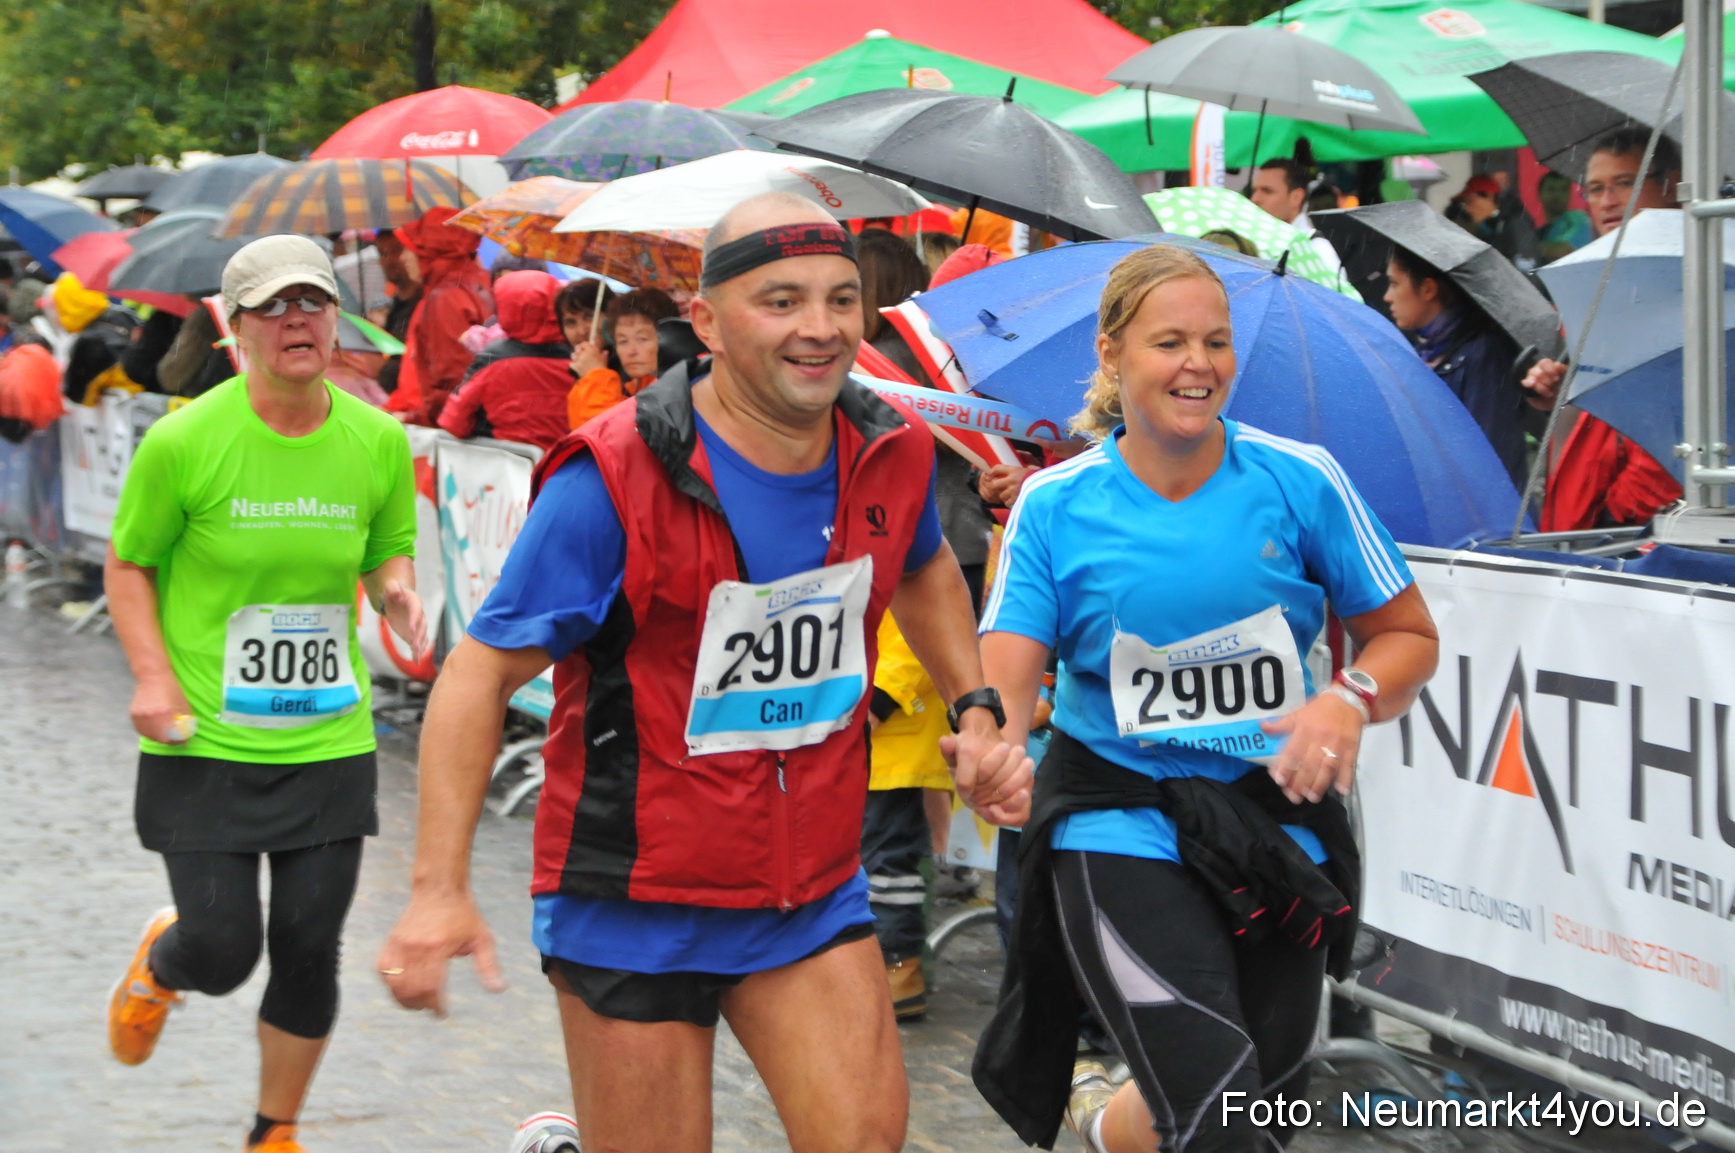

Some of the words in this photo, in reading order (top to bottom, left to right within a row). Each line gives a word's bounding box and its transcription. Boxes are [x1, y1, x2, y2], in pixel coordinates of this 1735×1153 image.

[976, 408, 1013, 434] TUI
[239, 638, 340, 685] 3086
[716, 608, 845, 692] 2901
[1168, 634, 1240, 661] BOCK
[271, 695, 318, 713] Gerdi
[760, 698, 803, 724] Can
[1132, 655, 1286, 726] 2900
[1400, 870, 1533, 933] INTERNETLÖSUNGEN
[1552, 912, 1721, 993] SCHULUNGSZENTRUM
[1499, 995, 1735, 1110] www.nathus-media.
